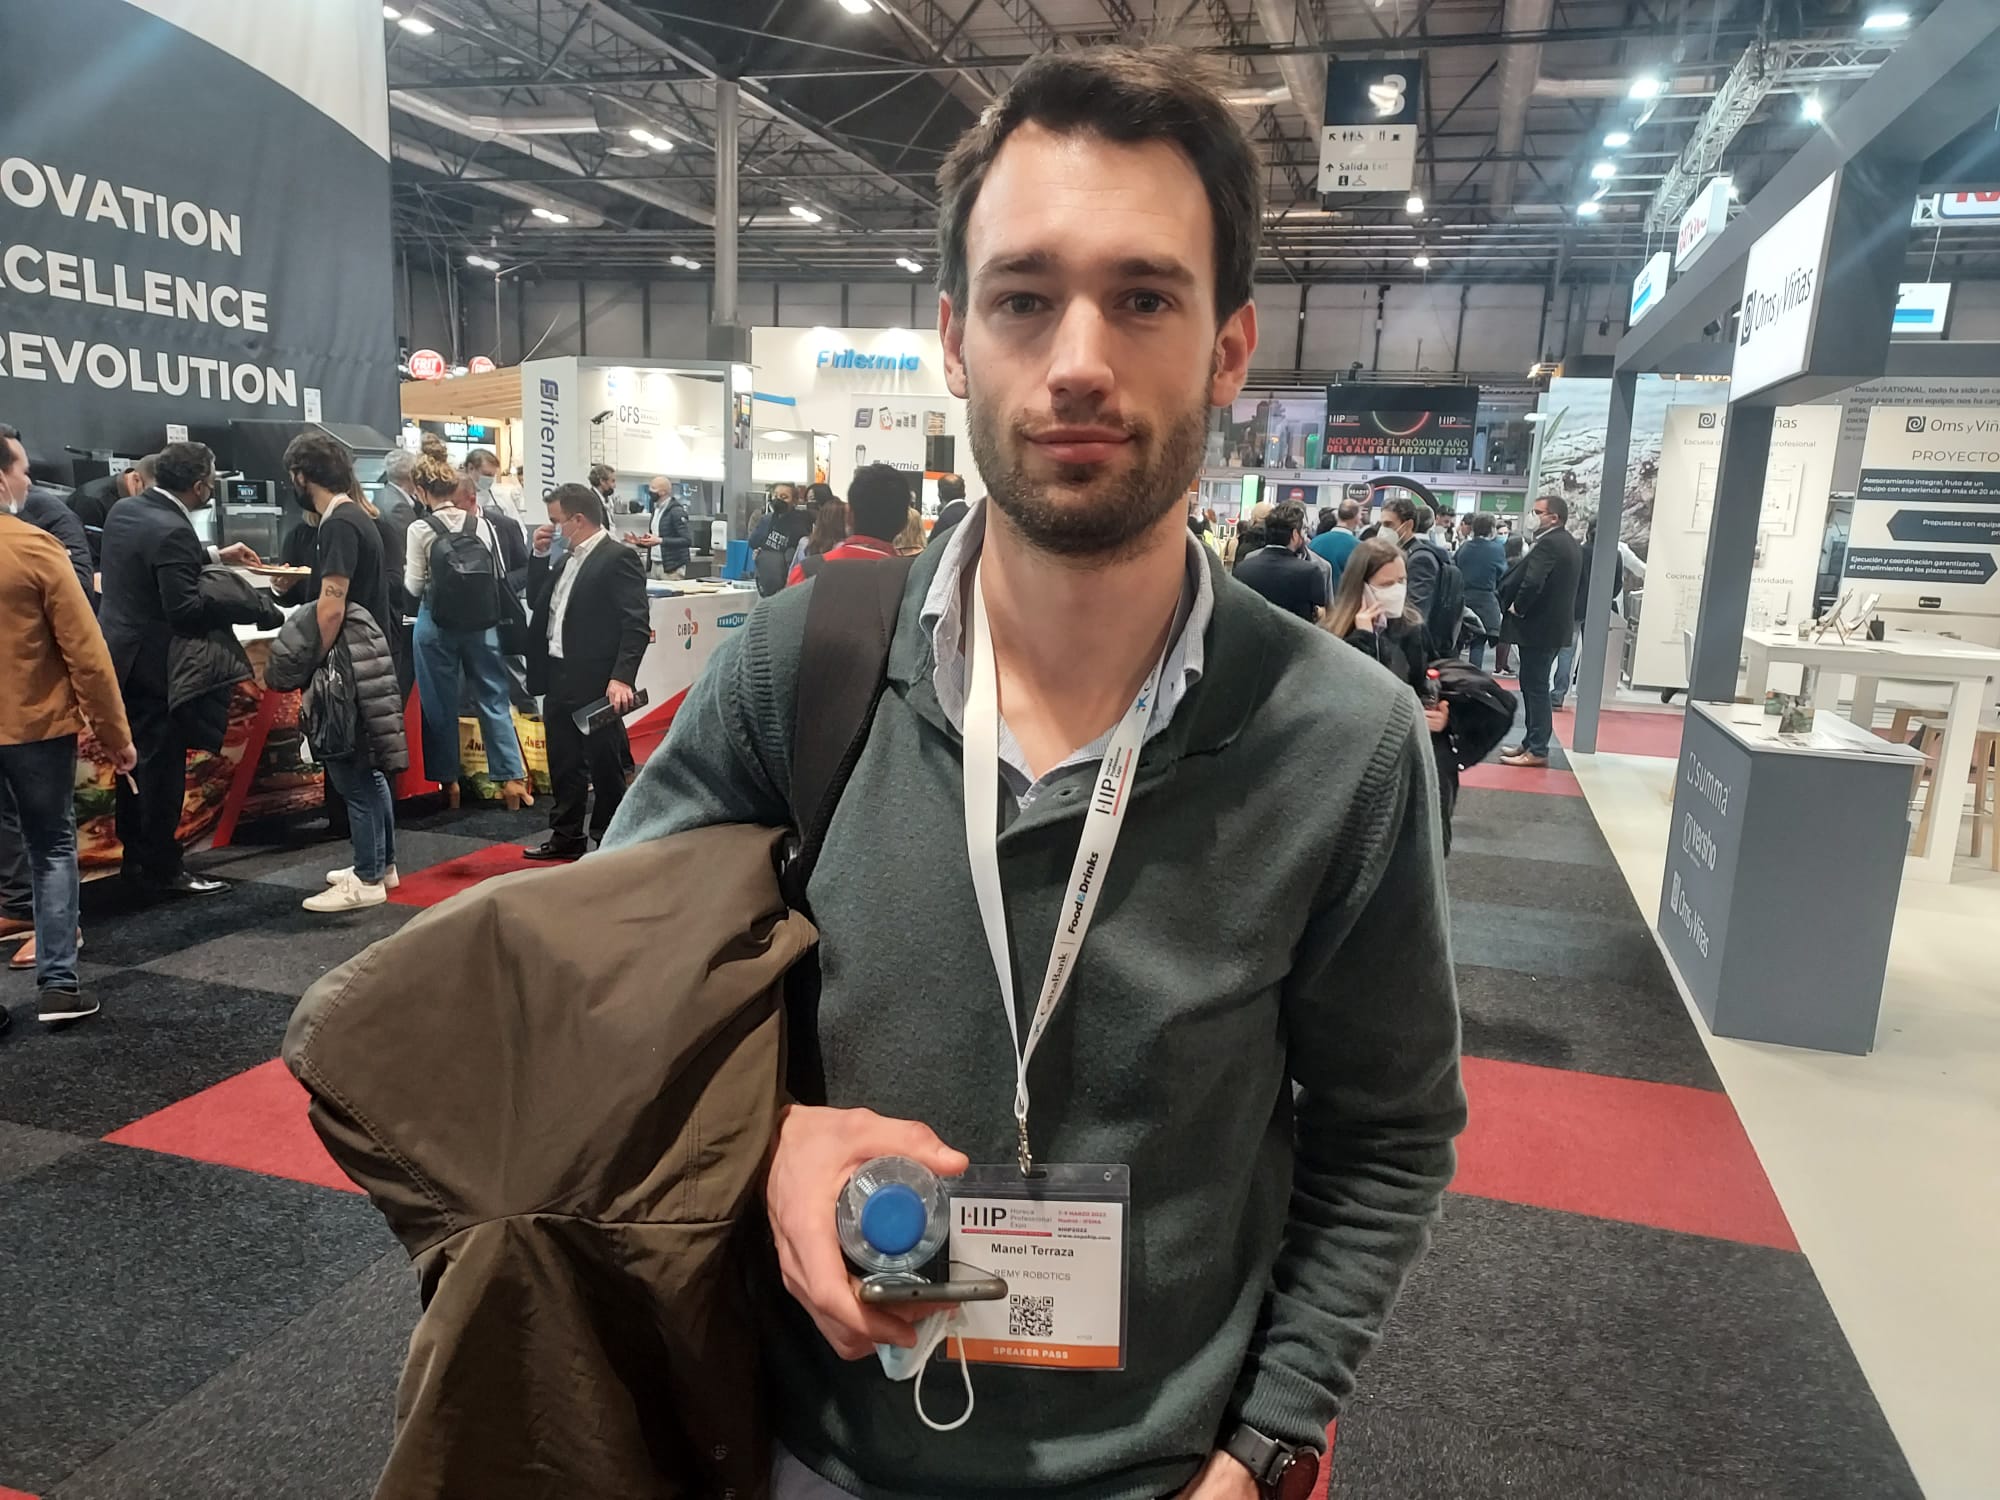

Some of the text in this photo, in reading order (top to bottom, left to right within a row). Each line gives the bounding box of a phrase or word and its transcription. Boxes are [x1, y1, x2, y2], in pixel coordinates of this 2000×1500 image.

[1339, 162, 1369, 171] Salida
[0, 241, 269, 333] CELLENCE
[1755, 292, 1777, 332] Oms
[1783, 266, 1814, 316] Viñas
[0, 331, 298, 408] EVOLUTION
[619, 405, 640, 424] CFS
[1774, 417, 1798, 429] ñas
[1930, 418, 2000, 434] Oms y Viñ
[1328, 437, 1468, 448] NOS VEMOS EL PRÓXIMO AÑO
[1683, 438, 1714, 446] Escuela
[1327, 445, 1344, 454] DEL
[1354, 446, 1367, 454] AL
[1376, 446, 1389, 455] DE
[1391, 446, 1427, 455] MARZO
[1429, 447, 1442, 455] DE
[1863, 478, 1915, 486] Asesoramiento
[1915, 479, 1944, 487] integral,
[1901, 487, 1941, 495] experiencia
[1922, 519, 1961, 527] Propuestas
[1851, 555, 1883, 564] Ejecución
[1889, 558, 1933, 566] coordinación
[1934, 559, 1980, 568] garantizando
[1665, 572, 1695, 581] Cocinas
[1856, 564, 1904, 573] cumplimiento
[1914, 566, 1925, 574] los
[1925, 567, 1947, 575] plazos
[1948, 568, 1985, 576] acordados
[1695, 761, 1729, 817] summa
[1067, 851, 1099, 935] Food&Drinks
[1679, 890, 1692, 929] Oms
[1040, 952, 1069, 1016] CaixaBank
[991, 1243, 1075, 1257] Manel Terraza
[994, 1268, 1072, 1281] REMY ROBOTICS
[993, 1346, 1069, 1359] SPEAKER PASS
